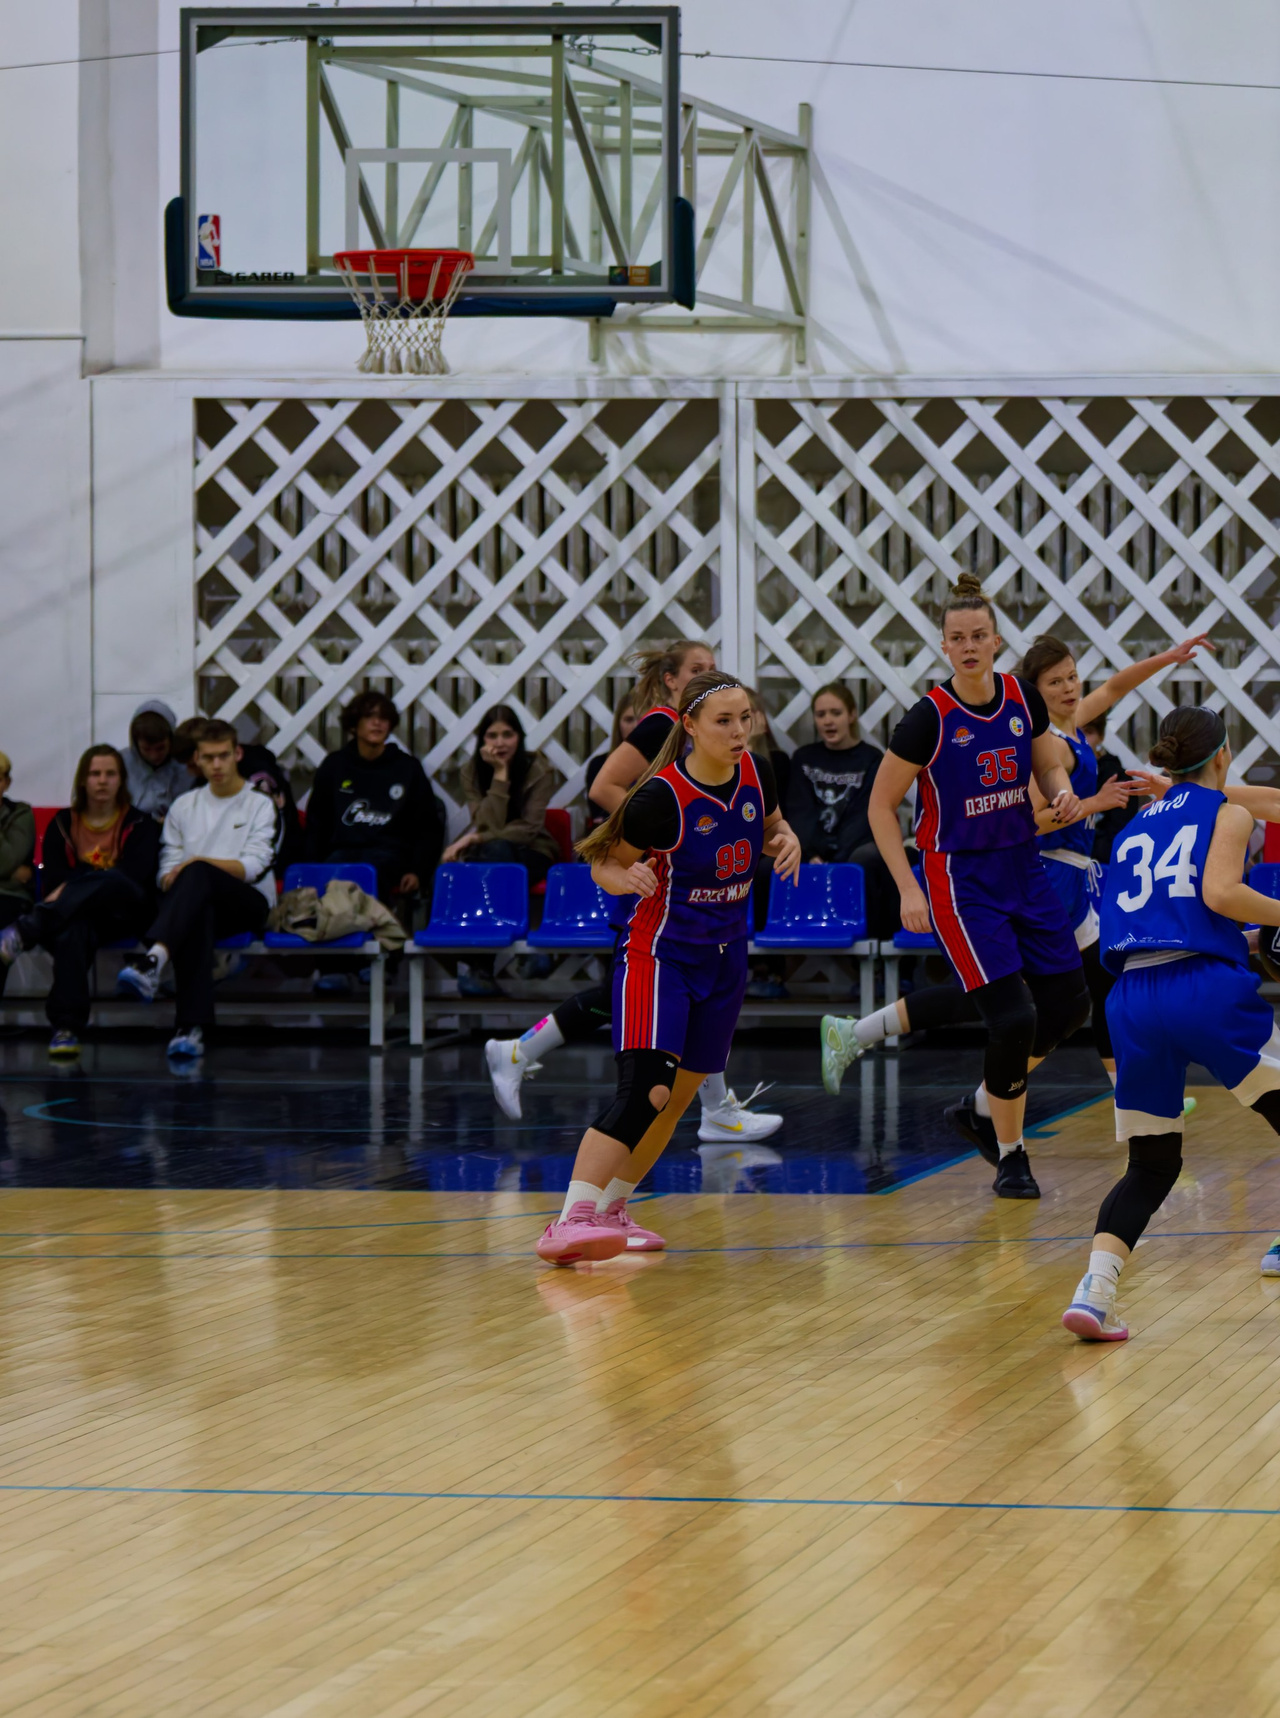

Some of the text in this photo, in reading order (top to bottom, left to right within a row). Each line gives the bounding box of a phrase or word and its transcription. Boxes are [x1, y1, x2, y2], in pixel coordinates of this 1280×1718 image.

[976, 746, 1018, 787] 35
[715, 838, 752, 880] 99
[1116, 824, 1198, 913] 34
